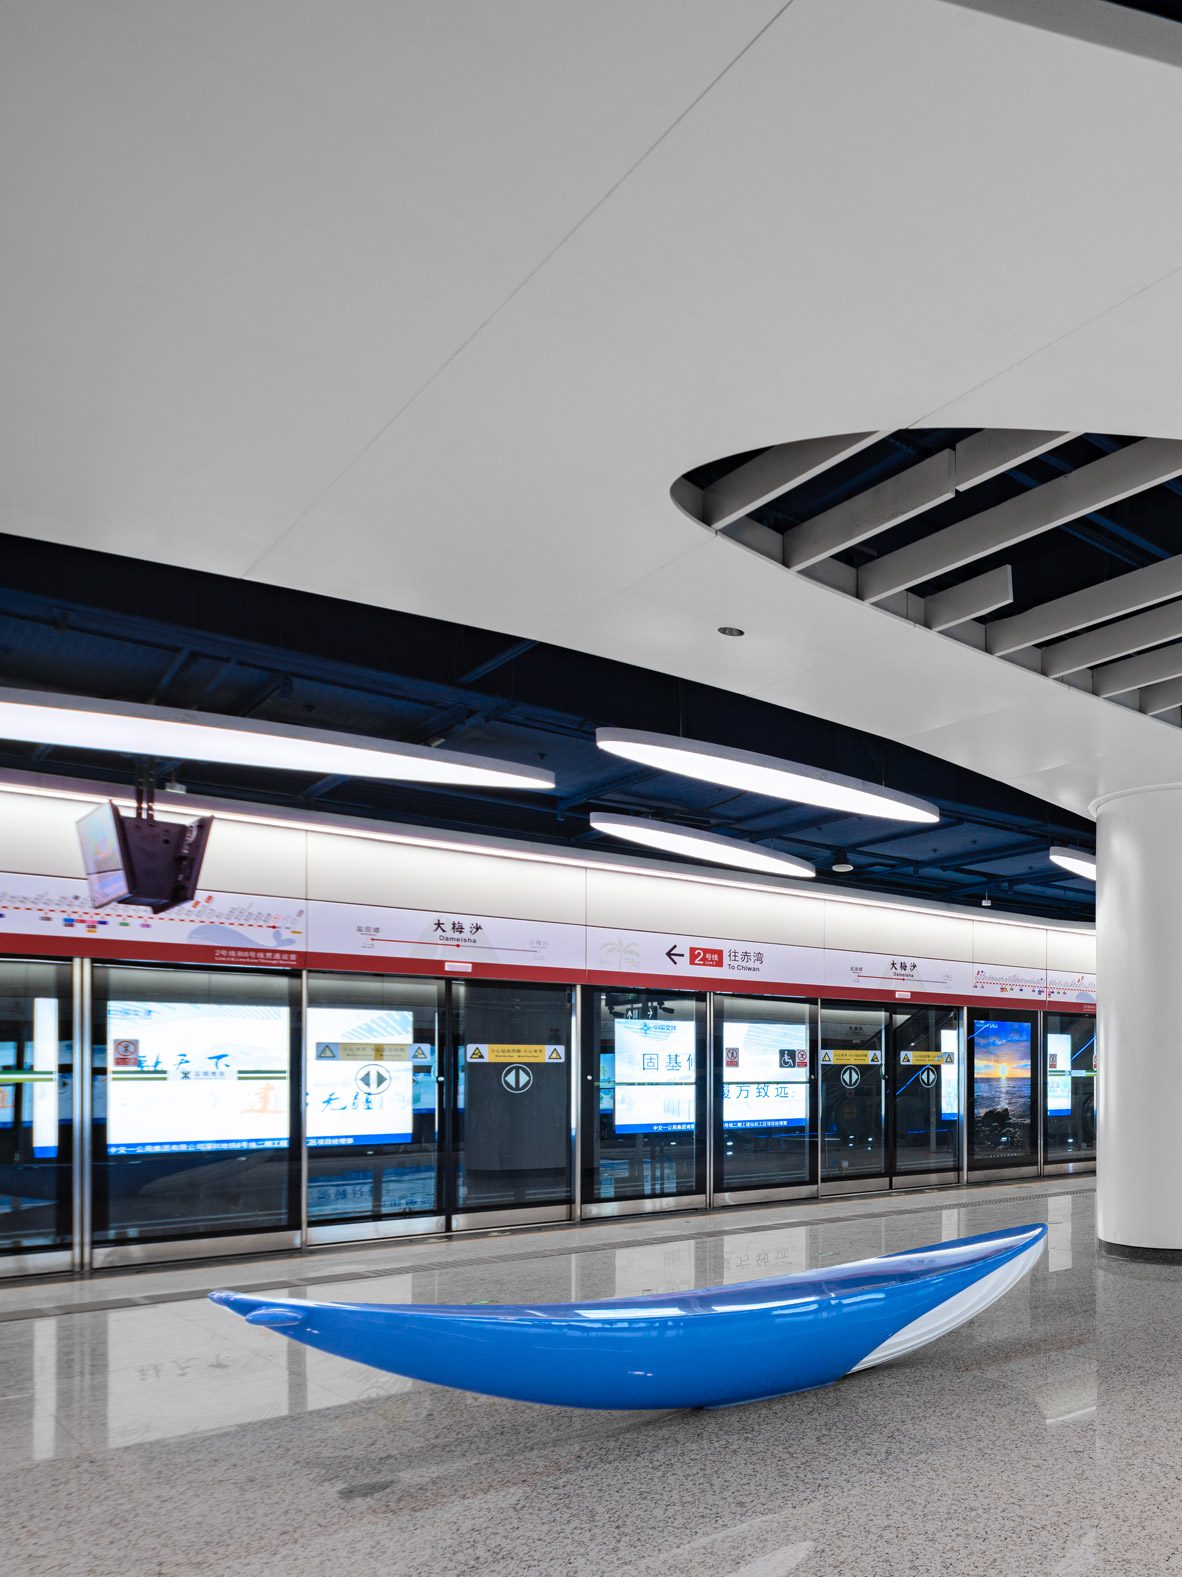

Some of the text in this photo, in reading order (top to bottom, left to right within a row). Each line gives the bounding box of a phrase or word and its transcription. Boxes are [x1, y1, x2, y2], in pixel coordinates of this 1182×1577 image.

[433, 918, 484, 936] 大梅沙
[438, 934, 478, 944] Dameisha
[694, 949, 719, 964] 2 号线
[727, 948, 765, 965] 往赤湾
[727, 963, 760, 973] To Chiwan
[890, 960, 918, 971] 大梅沙
